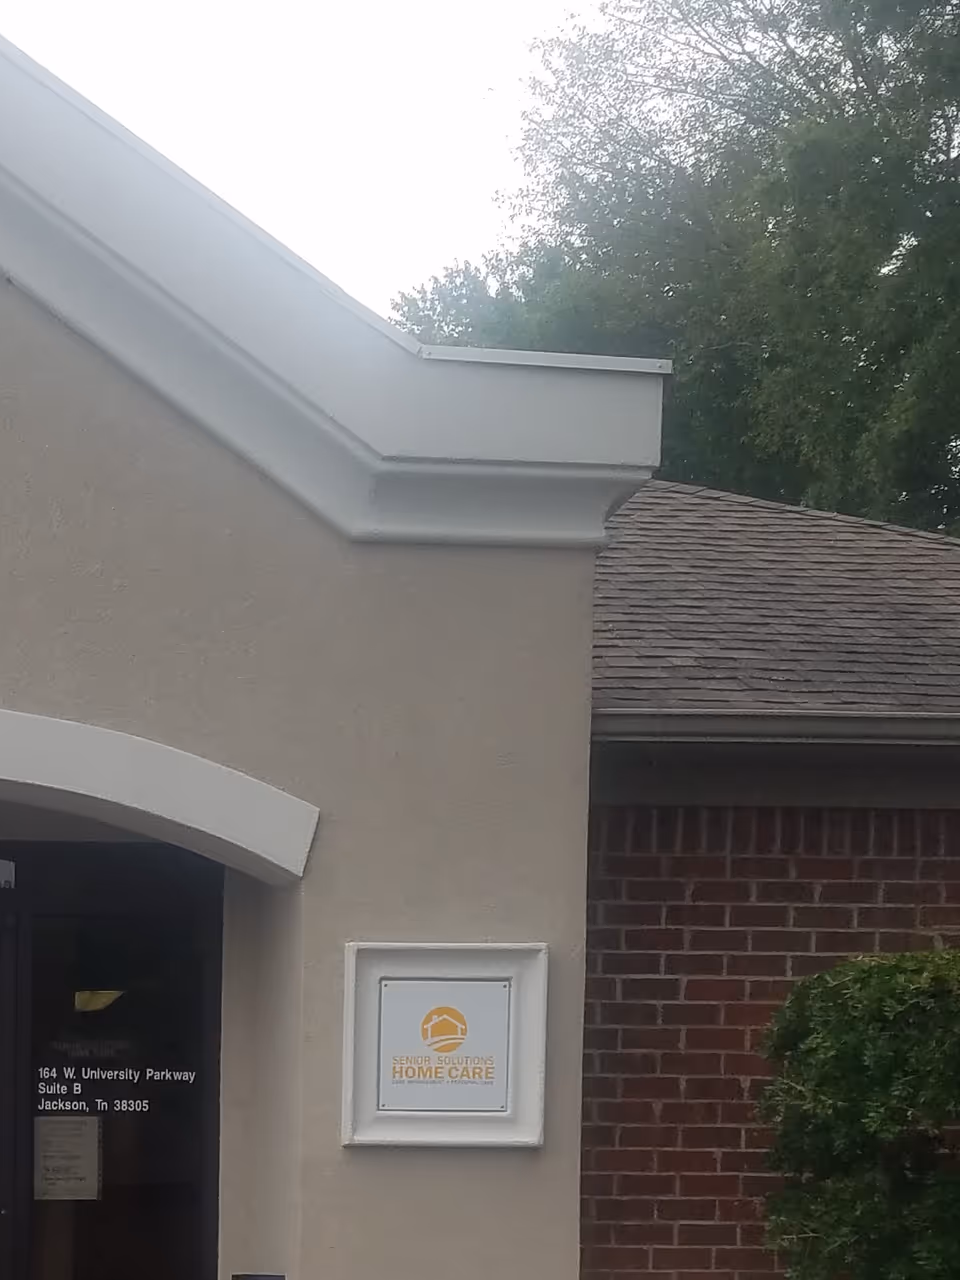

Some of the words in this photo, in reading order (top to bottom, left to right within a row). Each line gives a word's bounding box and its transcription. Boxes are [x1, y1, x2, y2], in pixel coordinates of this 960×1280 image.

[392, 1056, 430, 1066] SENIOR
[436, 1056, 494, 1066] SOLUTIONS
[38, 1067, 57, 1079] 164
[63, 1067, 77, 1079] W.
[81, 1068, 140, 1083] University
[146, 1068, 196, 1083] Parkway
[392, 1066, 445, 1079] HOME
[448, 1066, 495, 1080] CARE
[38, 1082, 68, 1094] Suite
[73, 1083, 82, 1094] B
[38, 1098, 90, 1112] Jackson,
[95, 1099, 108, 1111] Tn
[113, 1100, 149, 1111] 38305
